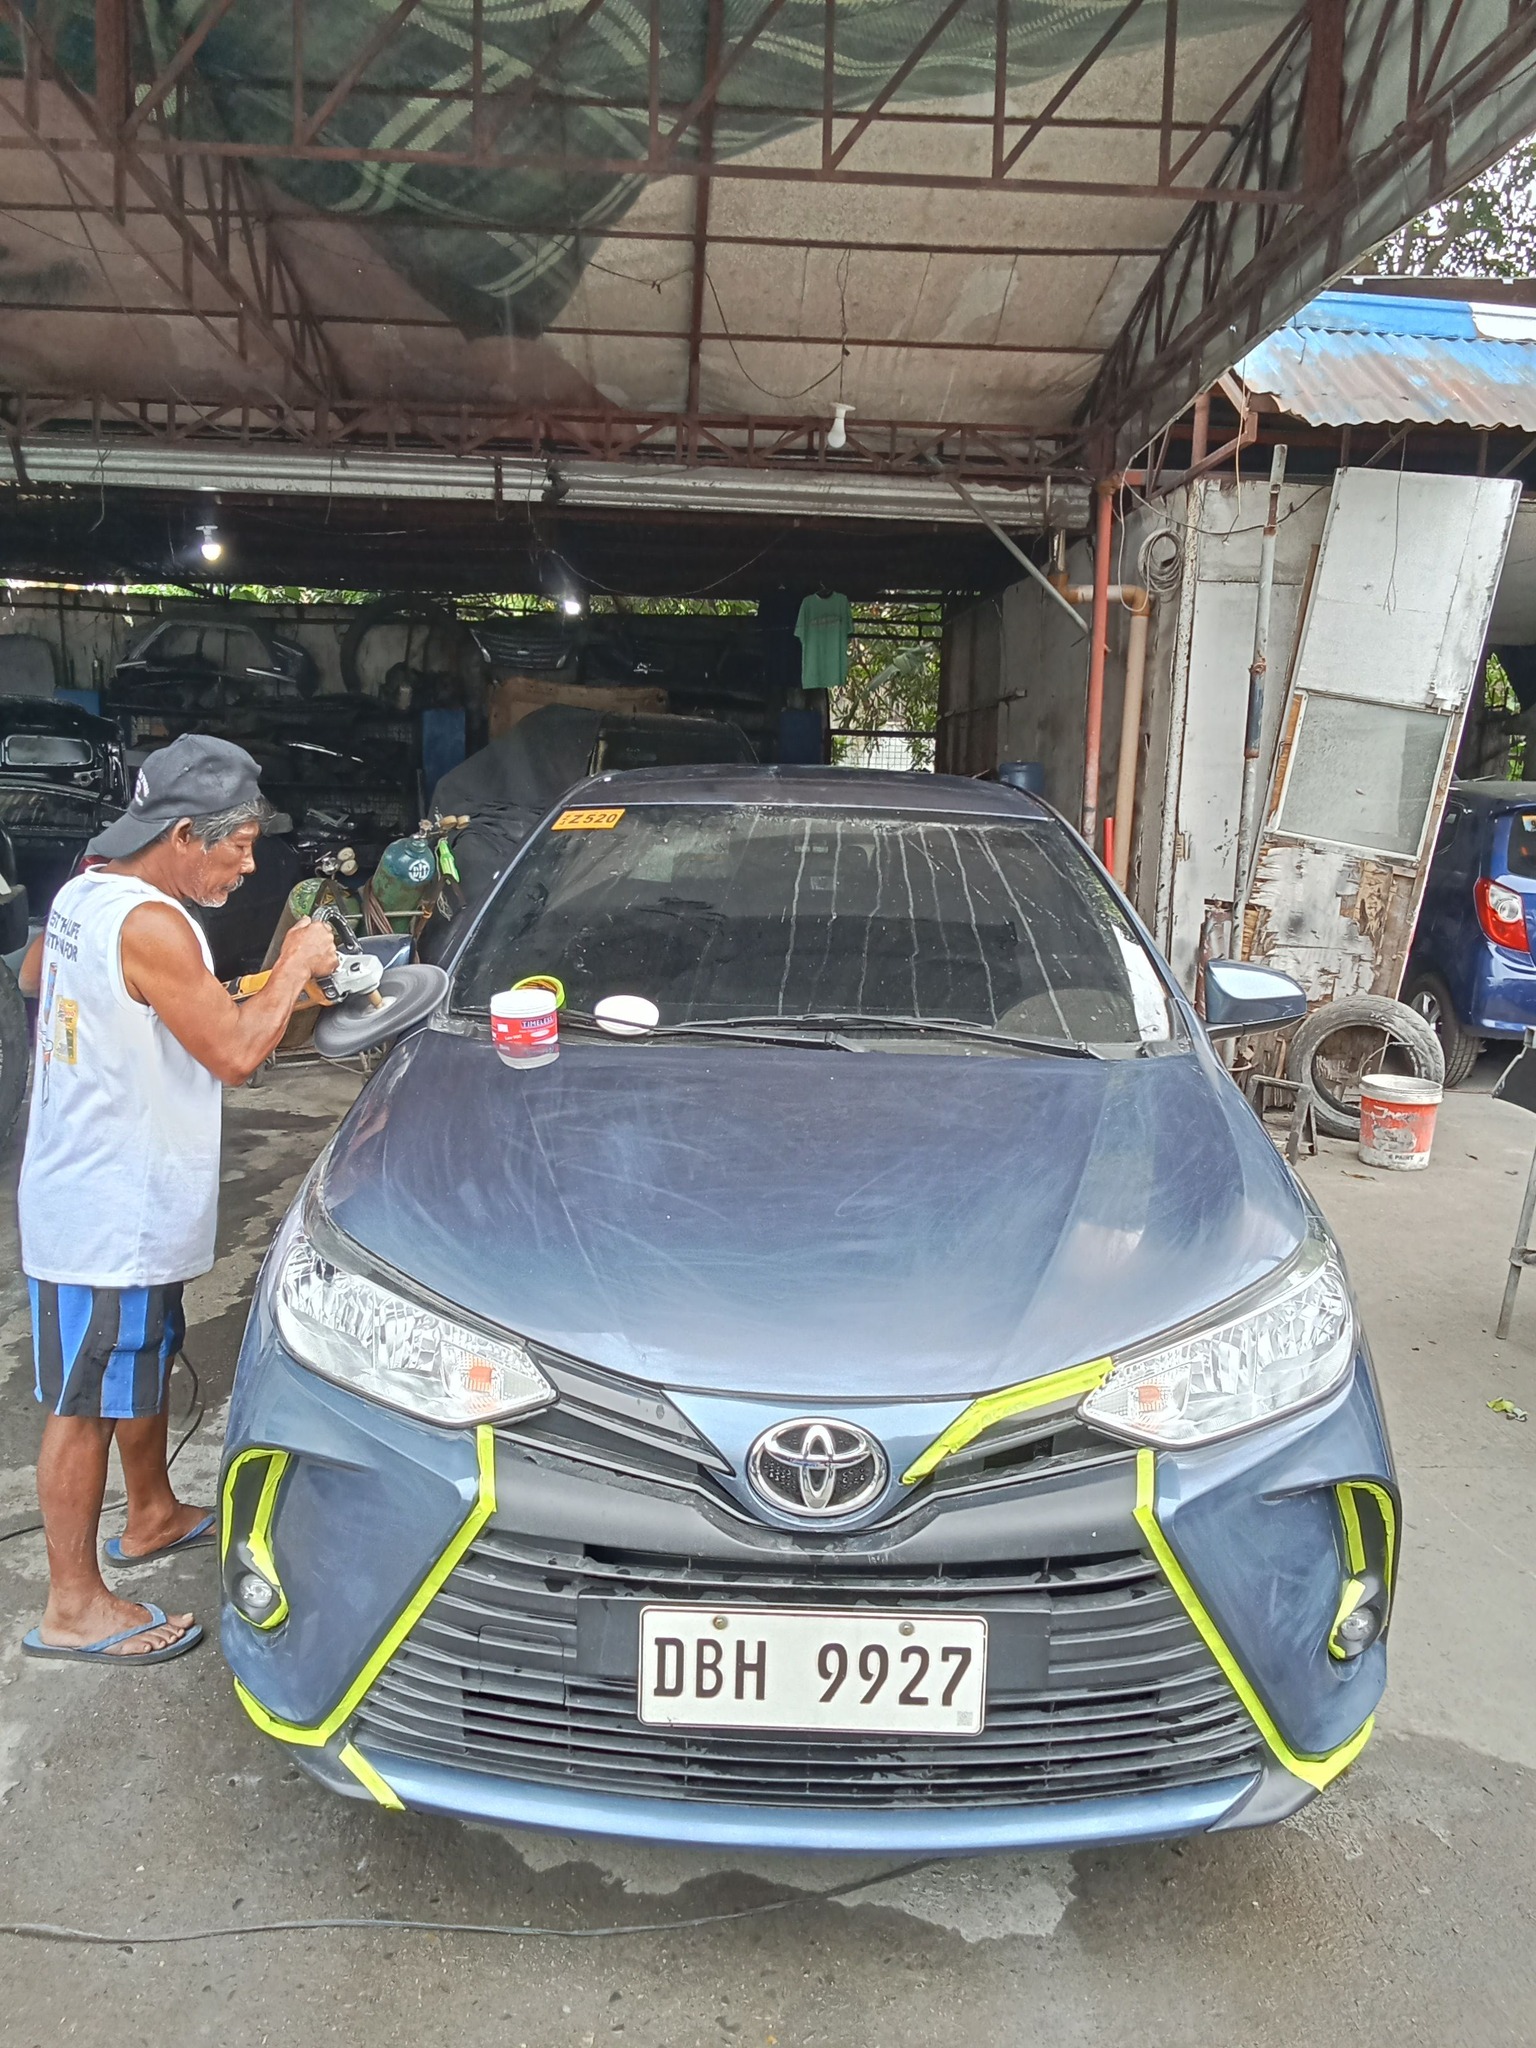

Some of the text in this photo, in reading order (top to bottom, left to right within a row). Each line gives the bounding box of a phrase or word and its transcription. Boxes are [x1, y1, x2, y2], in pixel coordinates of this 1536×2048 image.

[521, 1016, 554, 1028] TIMELESS
[653, 1636, 973, 1707] DBH 9927
